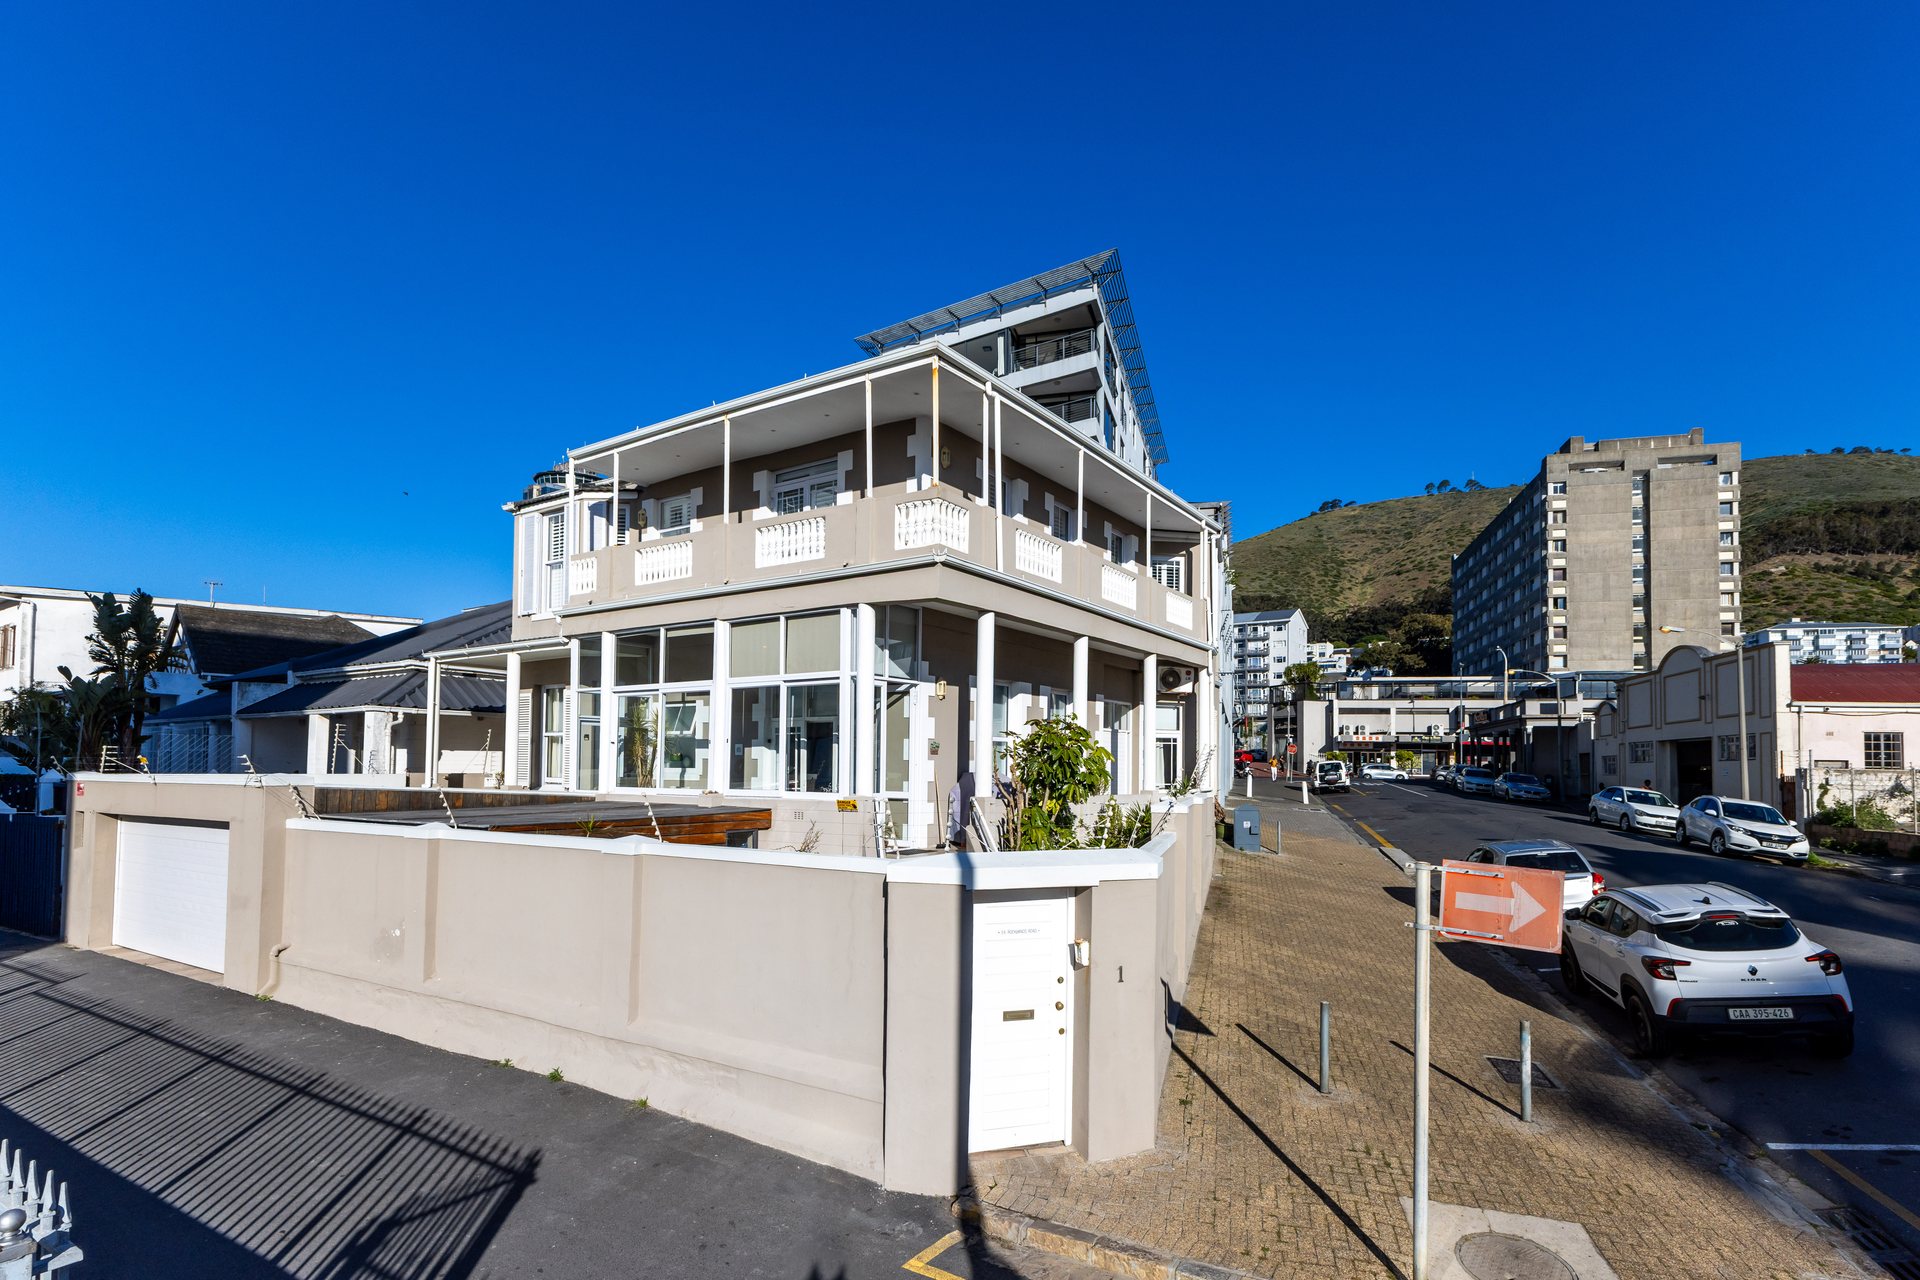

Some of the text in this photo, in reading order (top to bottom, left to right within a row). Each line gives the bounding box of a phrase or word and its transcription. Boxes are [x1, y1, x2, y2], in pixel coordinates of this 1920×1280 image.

[1118, 965, 1124, 983] 1
[1732, 1008, 1790, 1019] CAA 395-426
